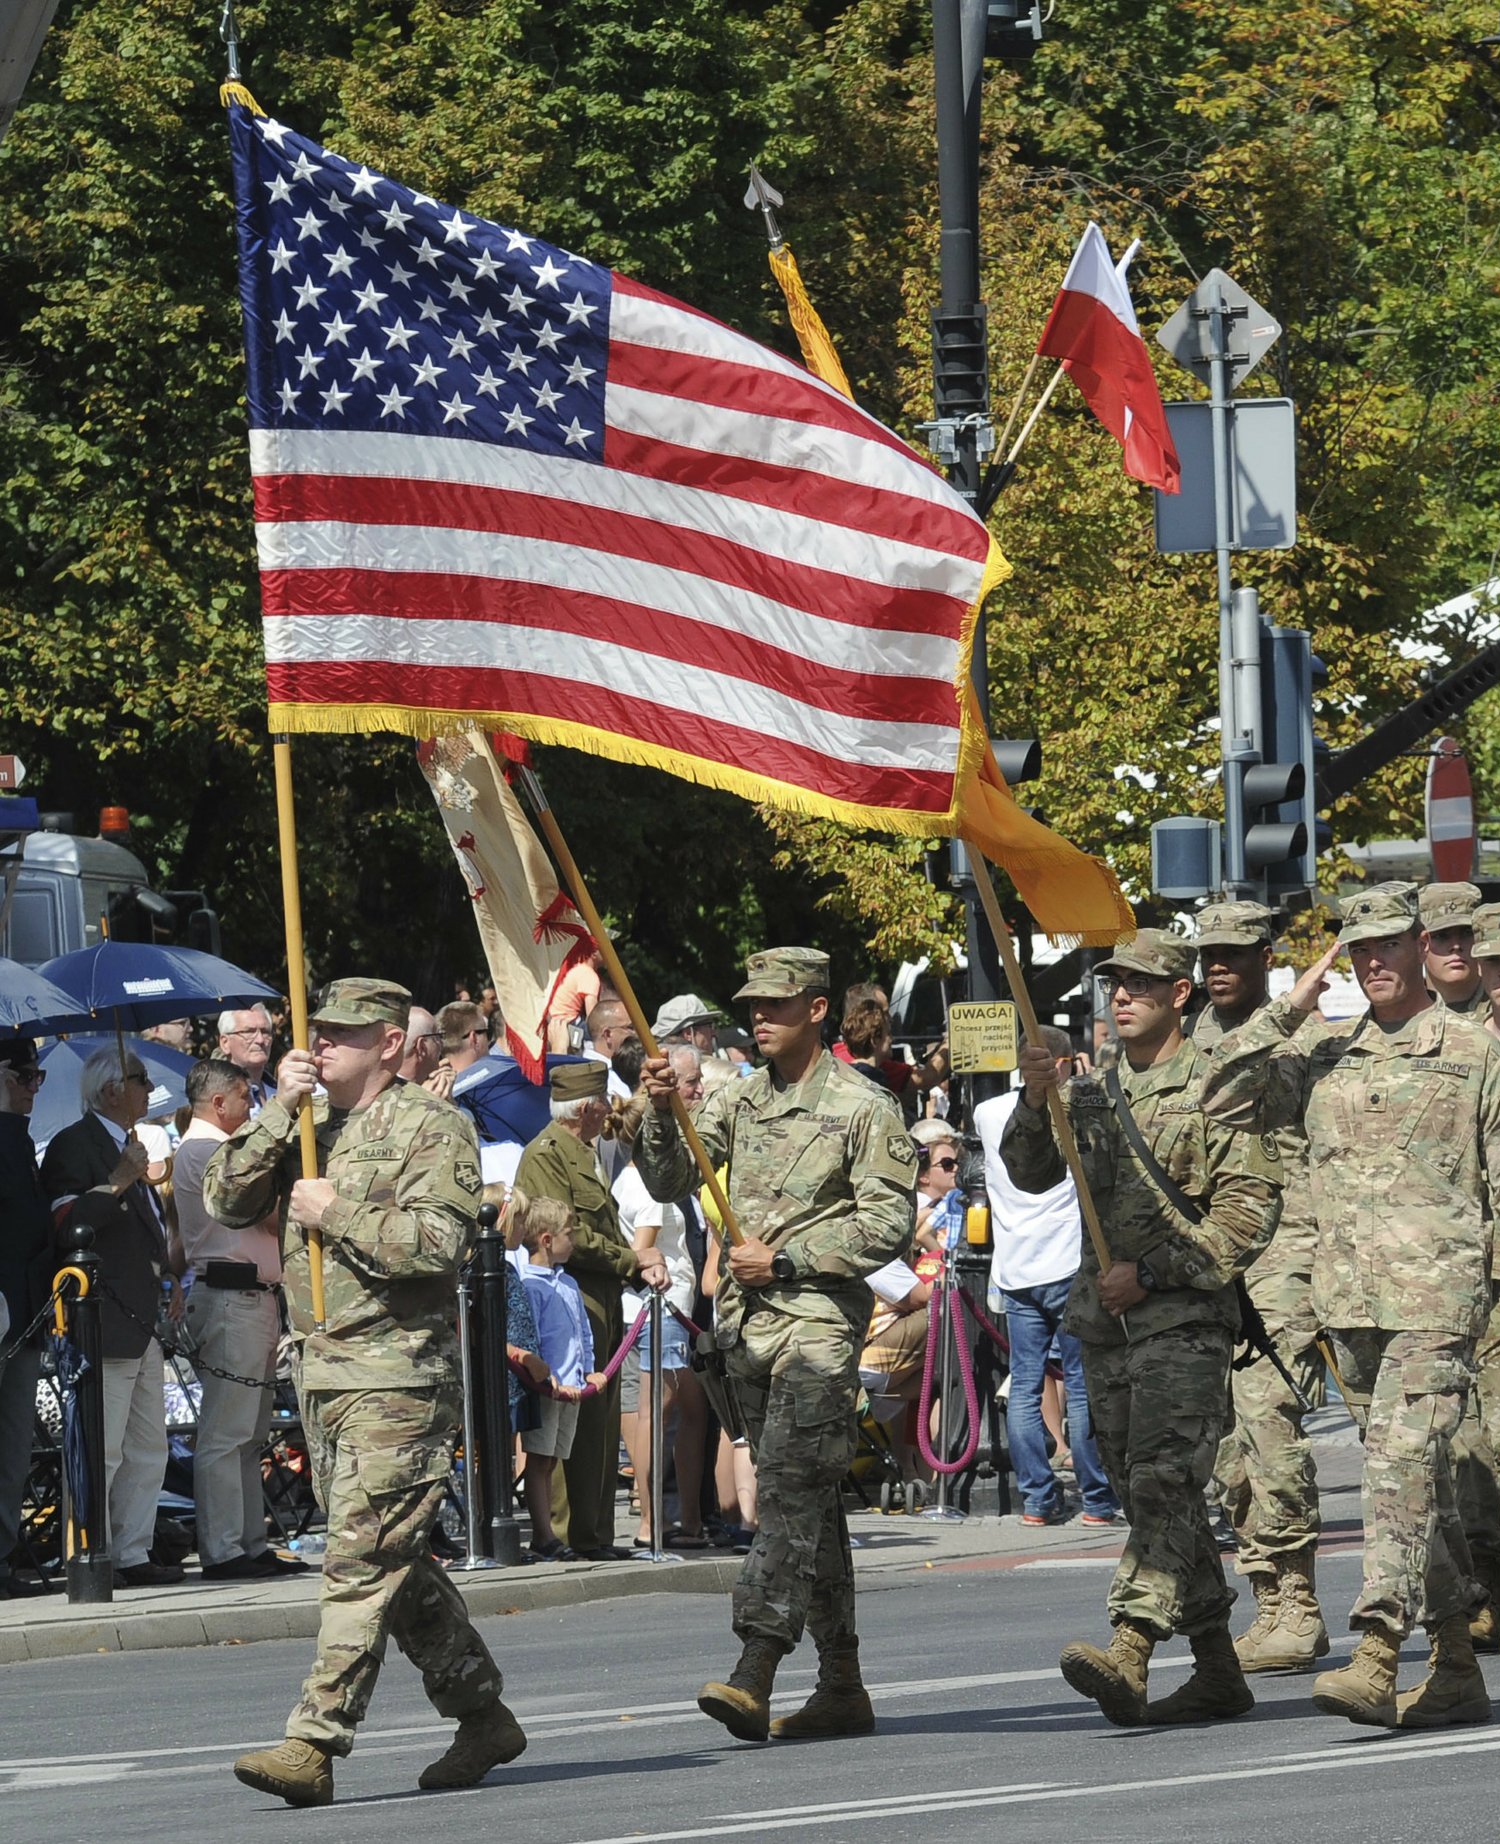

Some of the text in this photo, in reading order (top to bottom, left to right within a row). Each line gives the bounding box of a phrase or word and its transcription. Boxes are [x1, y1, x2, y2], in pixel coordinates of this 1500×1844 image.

[952, 1007, 1012, 1020] UWAGA!
[1433, 1062, 1463, 1073] ARMY
[371, 1148, 394, 1158] ARMY
